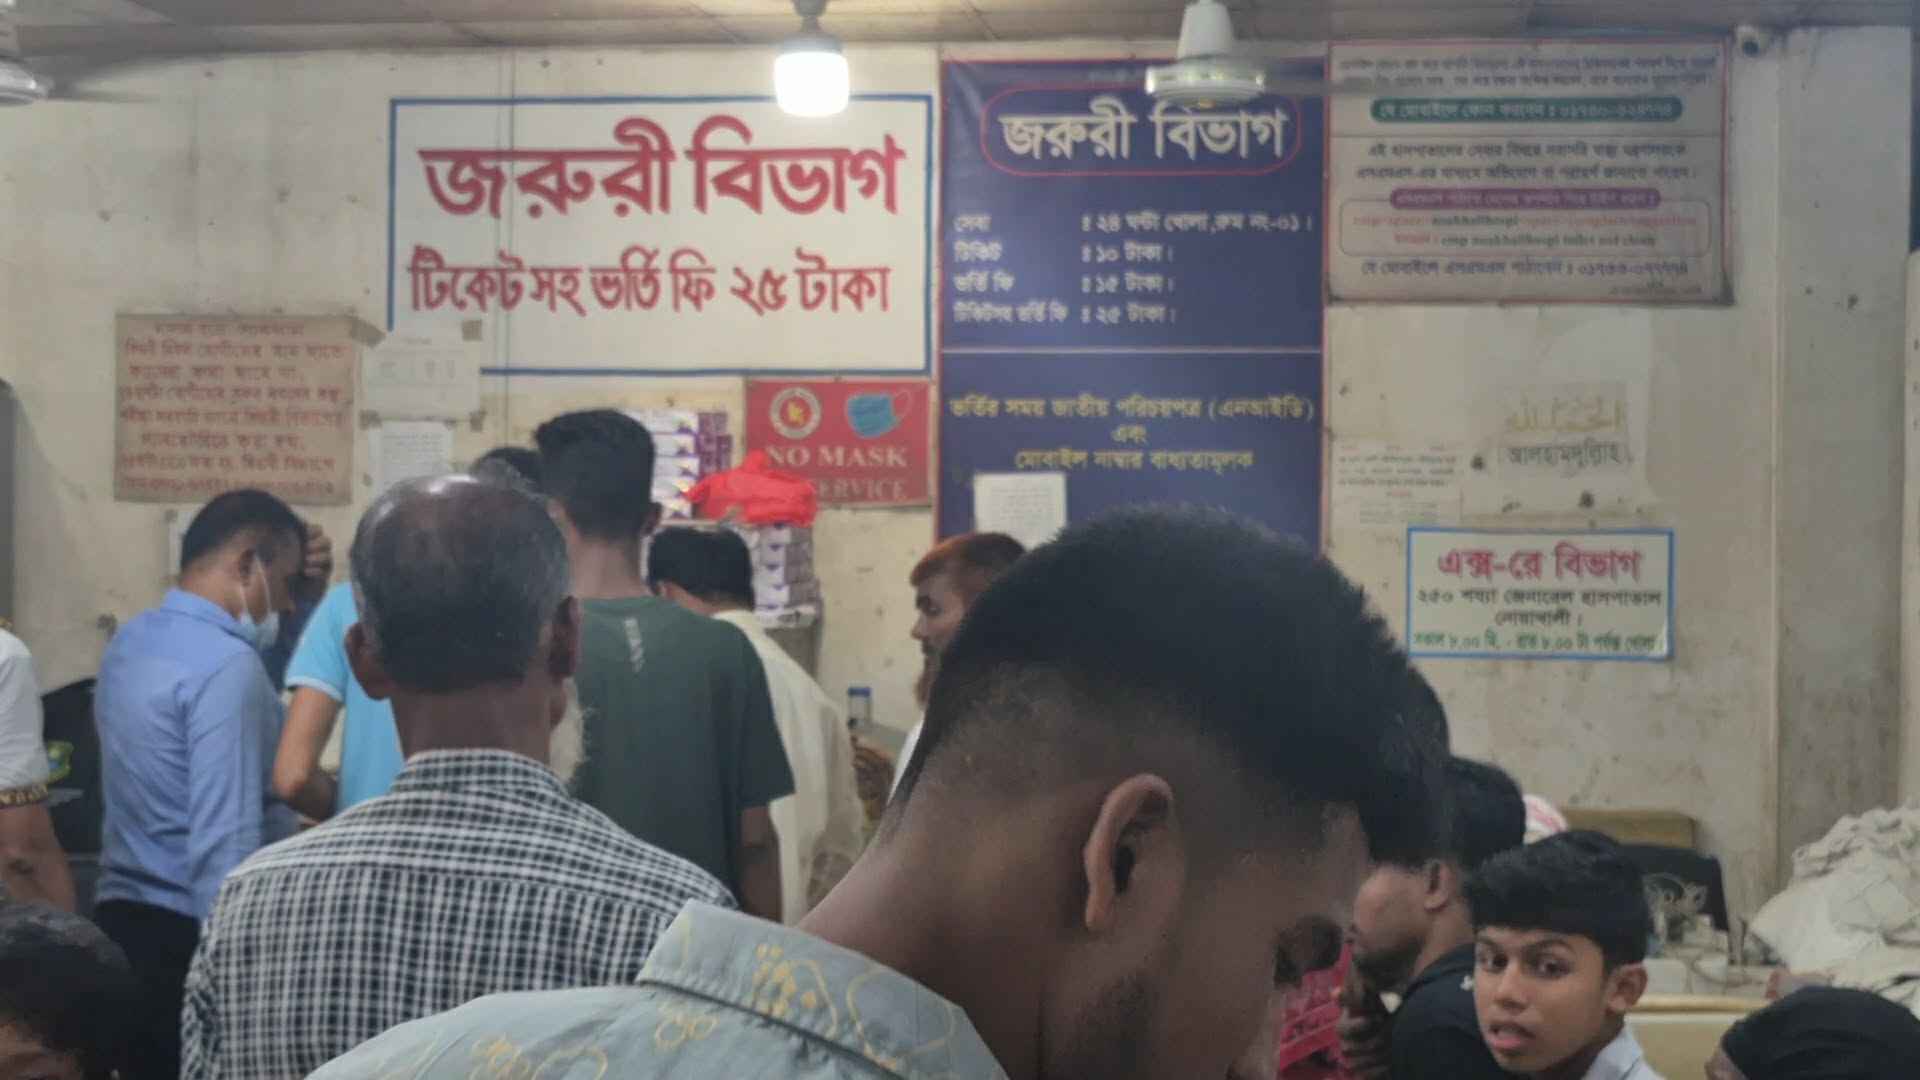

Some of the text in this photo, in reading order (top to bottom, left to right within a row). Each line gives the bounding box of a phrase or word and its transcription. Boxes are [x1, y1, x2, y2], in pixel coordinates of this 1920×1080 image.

[999, 95, 1288, 160] জরুরী বিভাগ
[418, 115, 906, 218] জরুরী বিভাগ
[590, 244, 663, 312] ভর্তি
[666, 247, 716, 313] ফি
[731, 268, 790, 316] ২৫
[795, 247, 893, 313] টাকা
[765, 445, 909, 468] NO MASK
[813, 478, 908, 501] ERVICE
[1438, 539, 1644, 583] এক্স-রে বিভাগ
